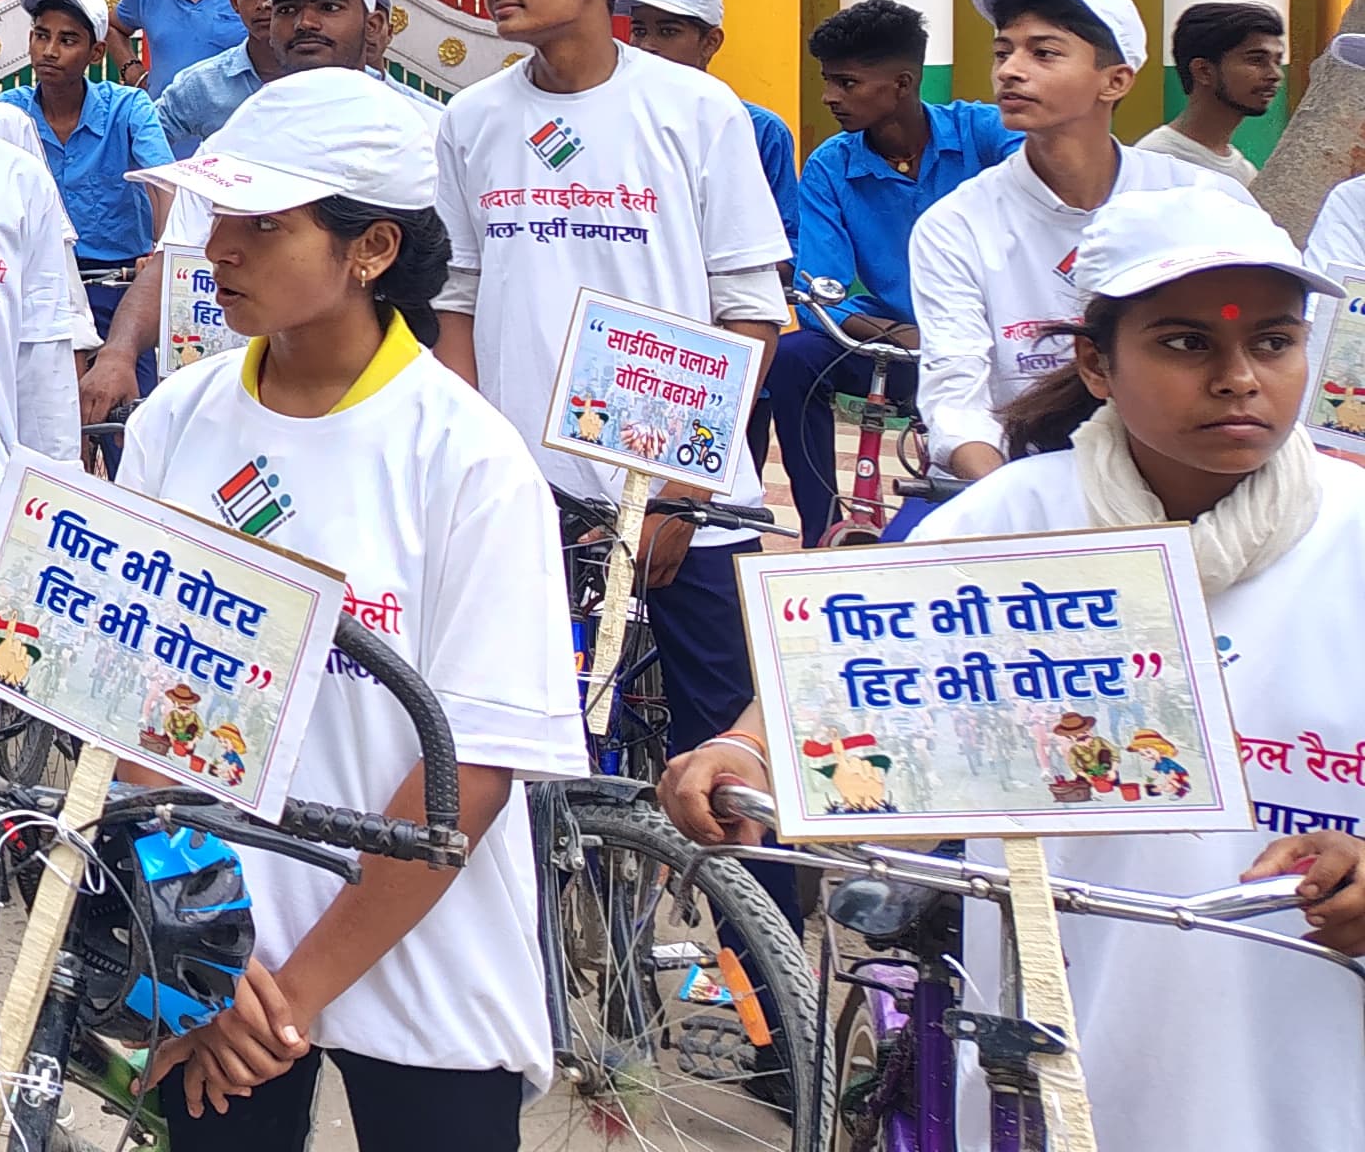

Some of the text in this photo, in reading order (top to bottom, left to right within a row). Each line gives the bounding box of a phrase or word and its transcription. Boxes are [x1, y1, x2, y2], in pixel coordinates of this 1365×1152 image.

[531, 182, 658, 213] साइकिल रैली
[529, 217, 648, 244] पूर्वी चम्पारण
[678, 344, 729, 382] चलाओ
[24, 496, 267, 640] “फिट भी वोटर
[33, 567, 272, 695] हिट भी वोटर”
[783, 581, 1119, 646] “फिट भी वोटर
[840, 648, 1163, 712] हिट भी वोटर”
